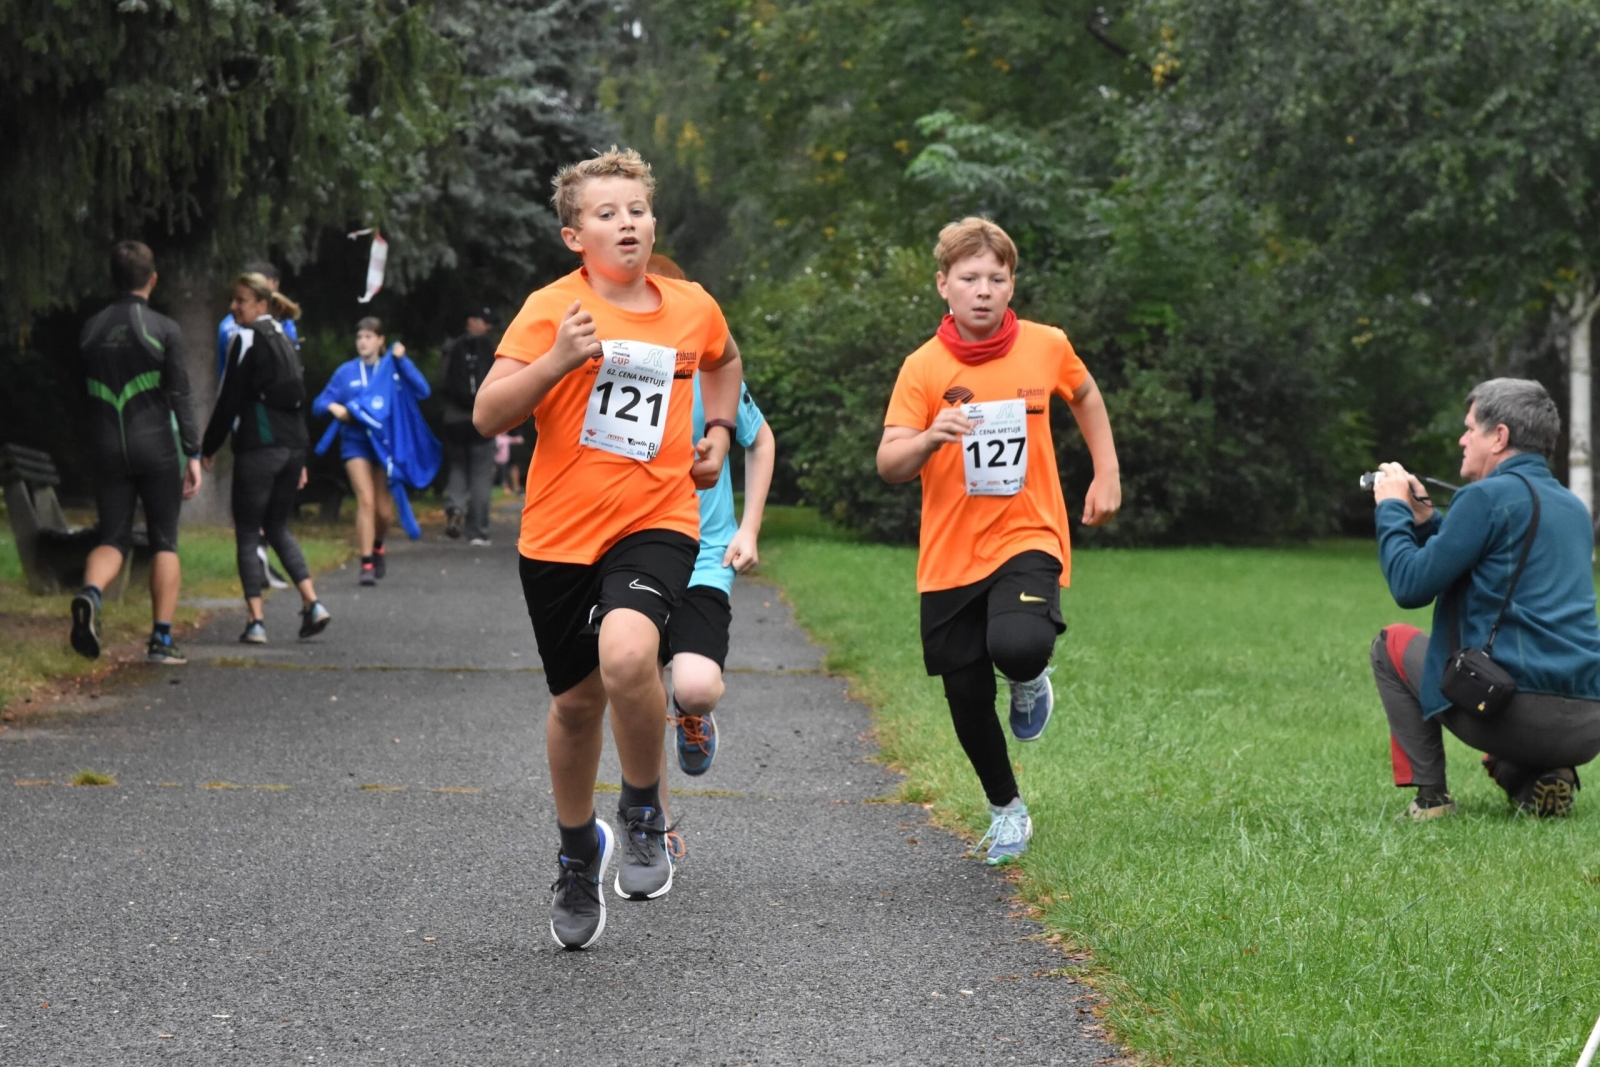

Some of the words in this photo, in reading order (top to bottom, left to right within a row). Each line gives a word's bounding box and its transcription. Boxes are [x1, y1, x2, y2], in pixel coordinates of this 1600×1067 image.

[611, 356, 630, 366] CUP
[606, 368, 617, 377] 62.
[618, 371, 637, 380] CENA
[638, 375, 666, 388] METUJE
[596, 381, 663, 427] 121
[979, 427, 996, 435] CENA
[998, 426, 1021, 434] METUJE
[966, 437, 1026, 468] 127
